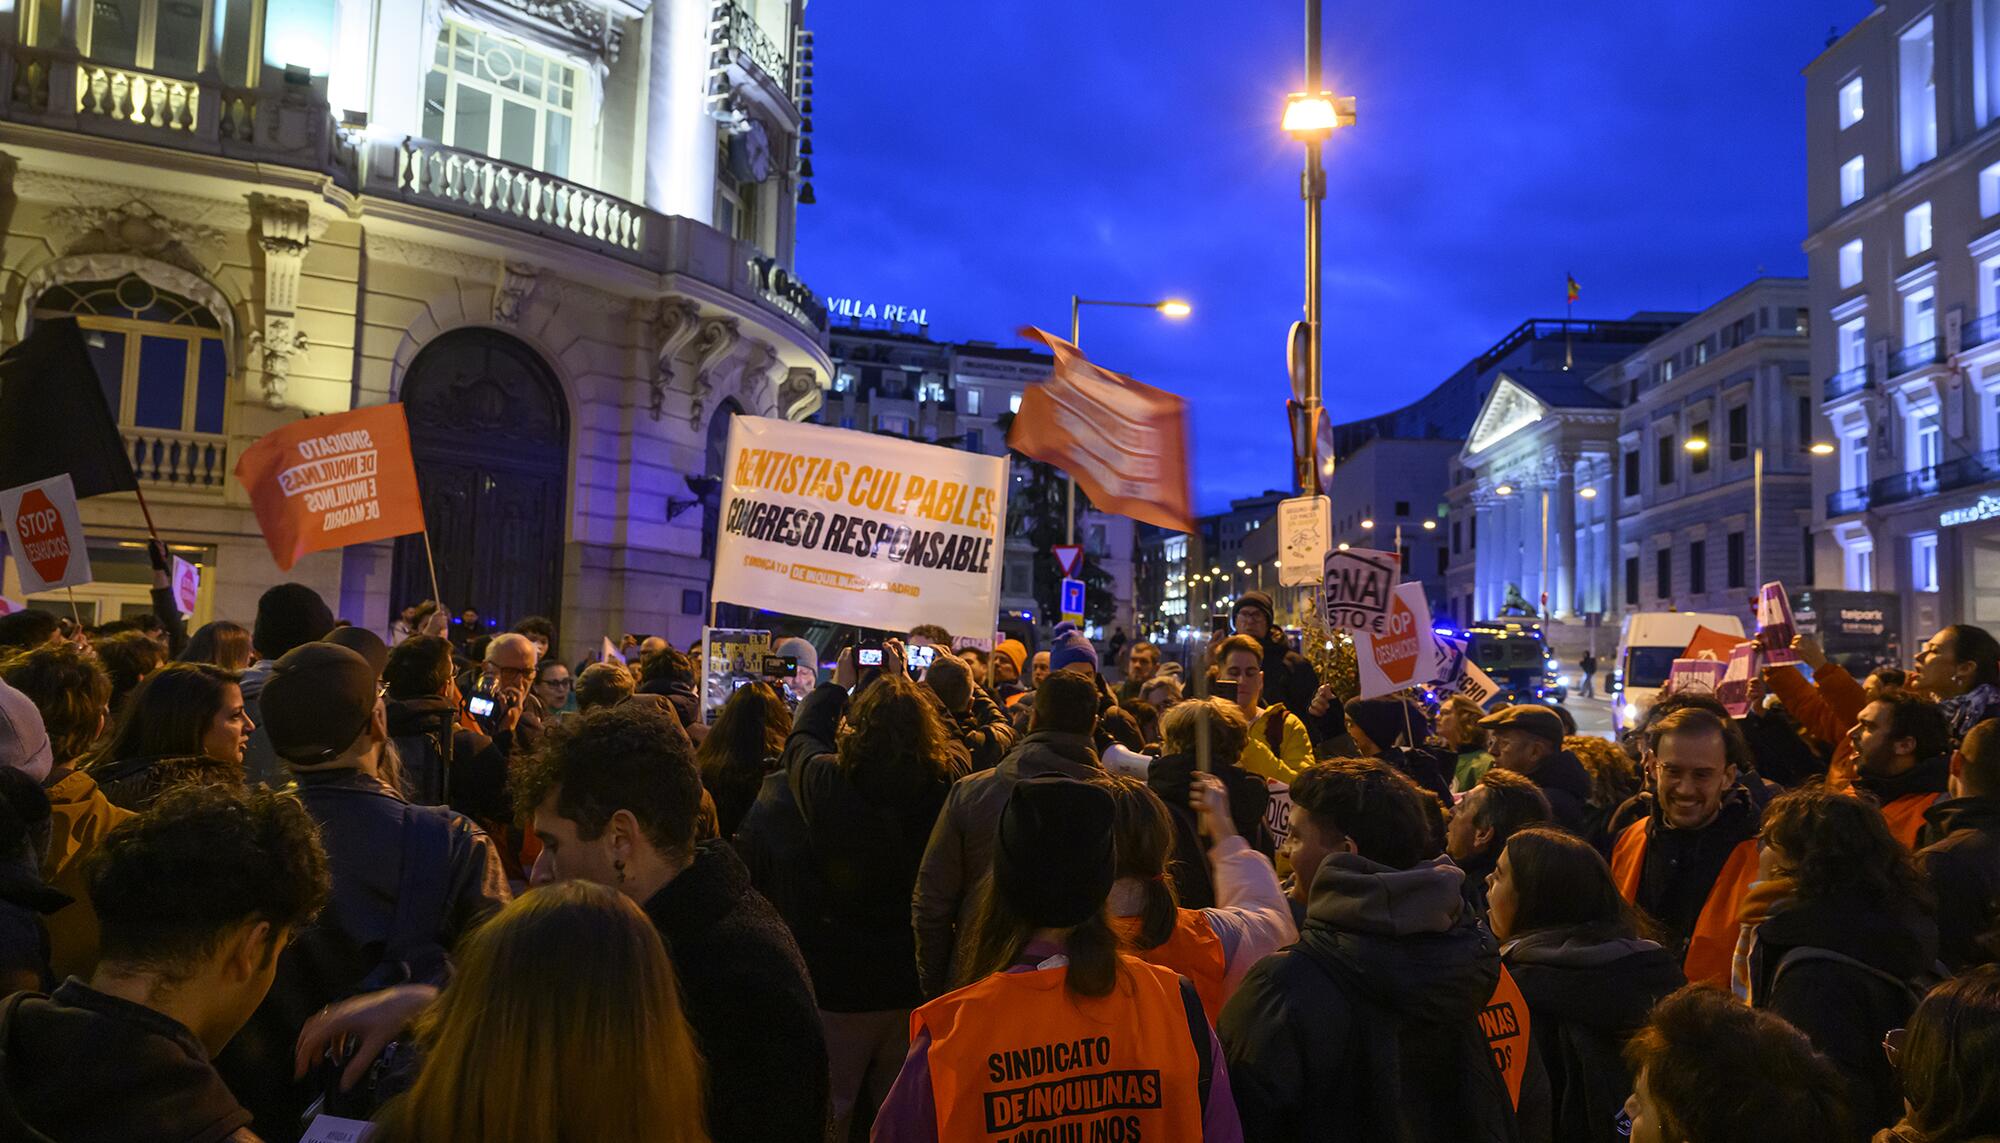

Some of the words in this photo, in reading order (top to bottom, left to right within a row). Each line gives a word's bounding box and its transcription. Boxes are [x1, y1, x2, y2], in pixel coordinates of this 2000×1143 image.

[827, 297, 877, 319] VILLA
[884, 304, 928, 325] REAL
[735, 448, 849, 501] RENTISTAS
[18, 508, 57, 538] STOP
[726, 498, 825, 549] CONGRESO
[822, 515, 993, 574] RESPONSABLE
[1326, 568, 1380, 607] GNA
[1329, 610, 1366, 628] STO
[1392, 611, 1411, 635] OP
[1456, 669, 1488, 703] ECHO
[1267, 798, 1290, 830] DIG
[988, 1036, 1110, 1083] SINDICATO
[993, 1092, 1025, 1128] DE
[1026, 1074, 1157, 1116] INQUILINAS
